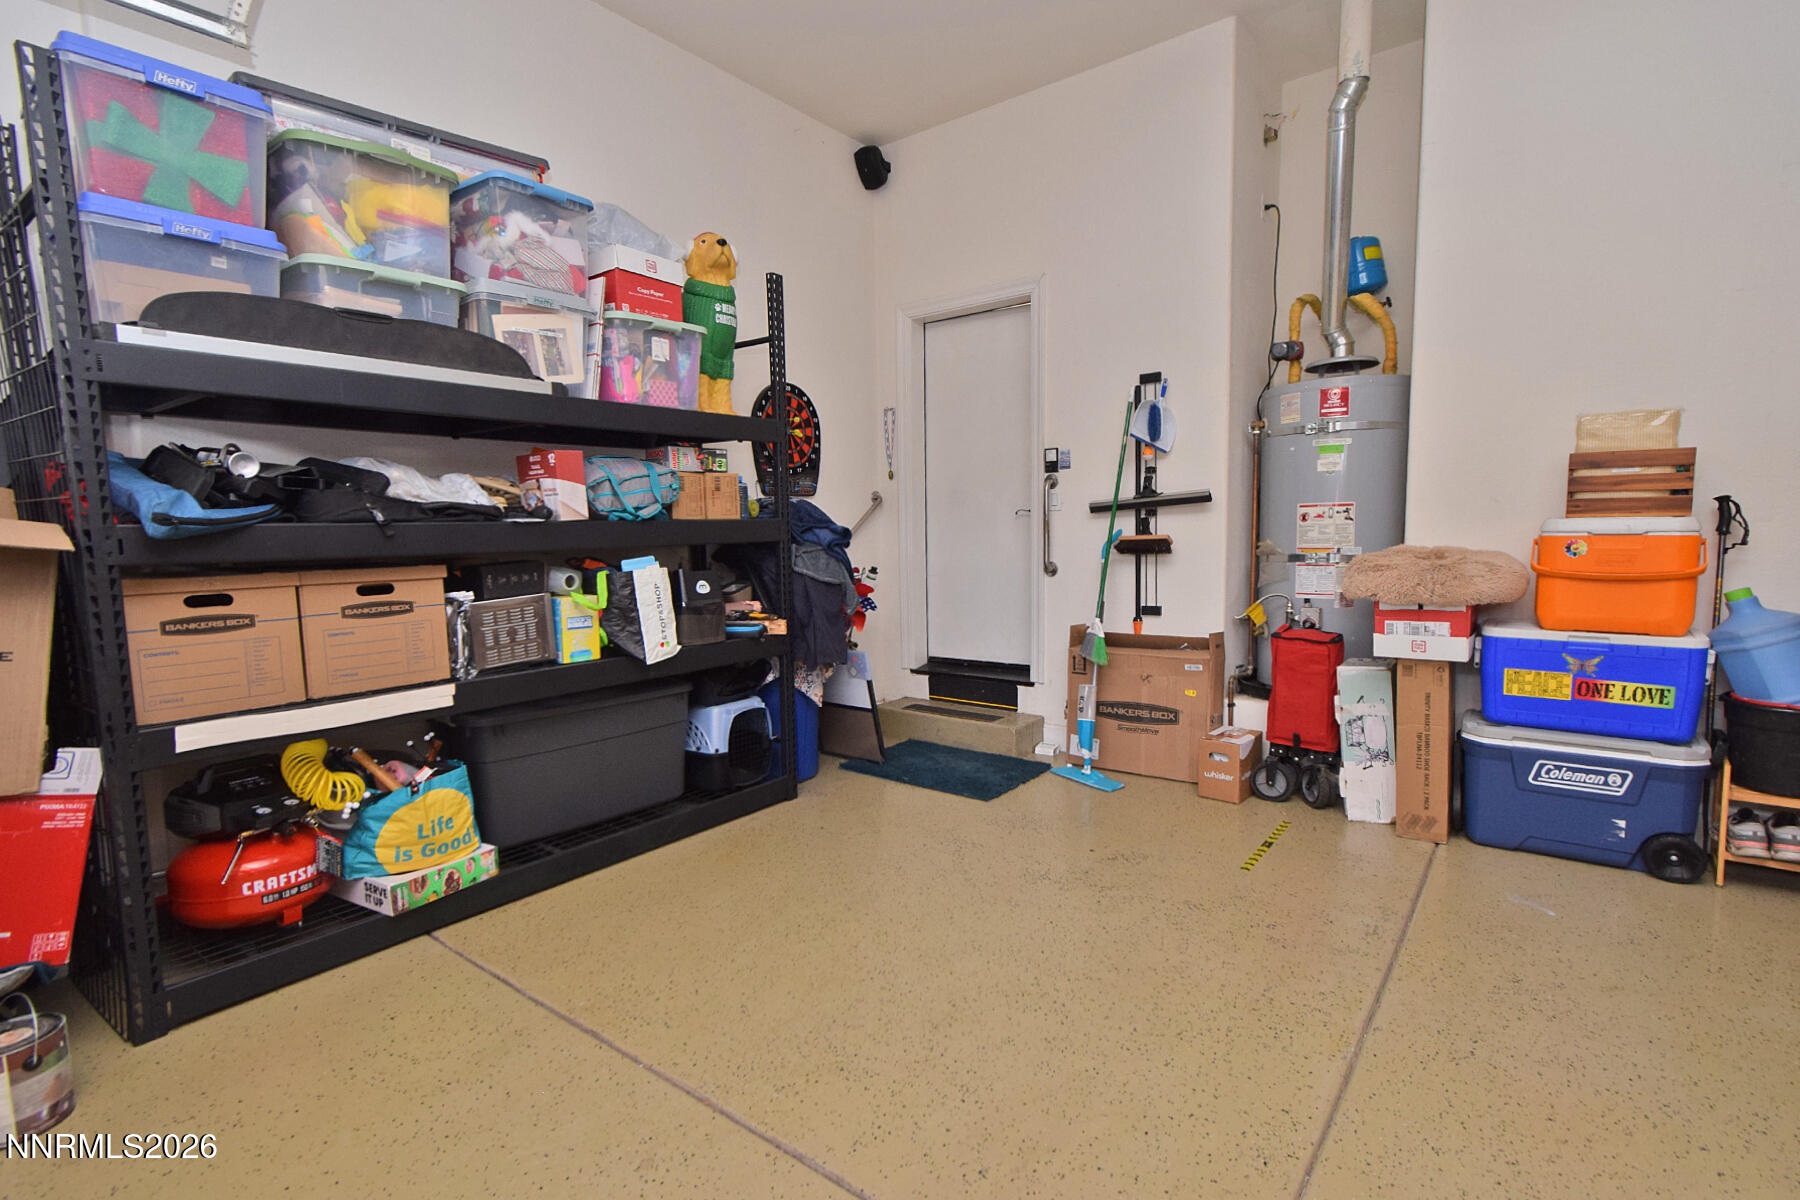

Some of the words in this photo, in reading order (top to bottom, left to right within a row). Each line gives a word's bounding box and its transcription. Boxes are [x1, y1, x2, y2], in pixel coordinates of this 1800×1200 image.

[158, 72, 194, 92] Hefty
[175, 224, 210, 240] Hefty
[344, 605, 390, 615] BANKERS
[392, 603, 412, 612] BOX
[165, 620, 225, 632] BANKERS
[226, 618, 251, 626] BOX
[1576, 680, 1616, 700] ONE
[1619, 685, 1672, 706] LOVE
[1098, 705, 1150, 718] BANKERS
[1151, 710, 1176, 720] BOX
[1203, 770, 1234, 781] whisker
[1540, 764, 1605, 785] Coleman
[417, 815, 455, 841] Life
[394, 845, 413, 863] is
[421, 829, 472, 858] Good
[363, 881, 389, 899] SERVE
[364, 894, 374, 904] IT
[373, 896, 384, 908] UP
